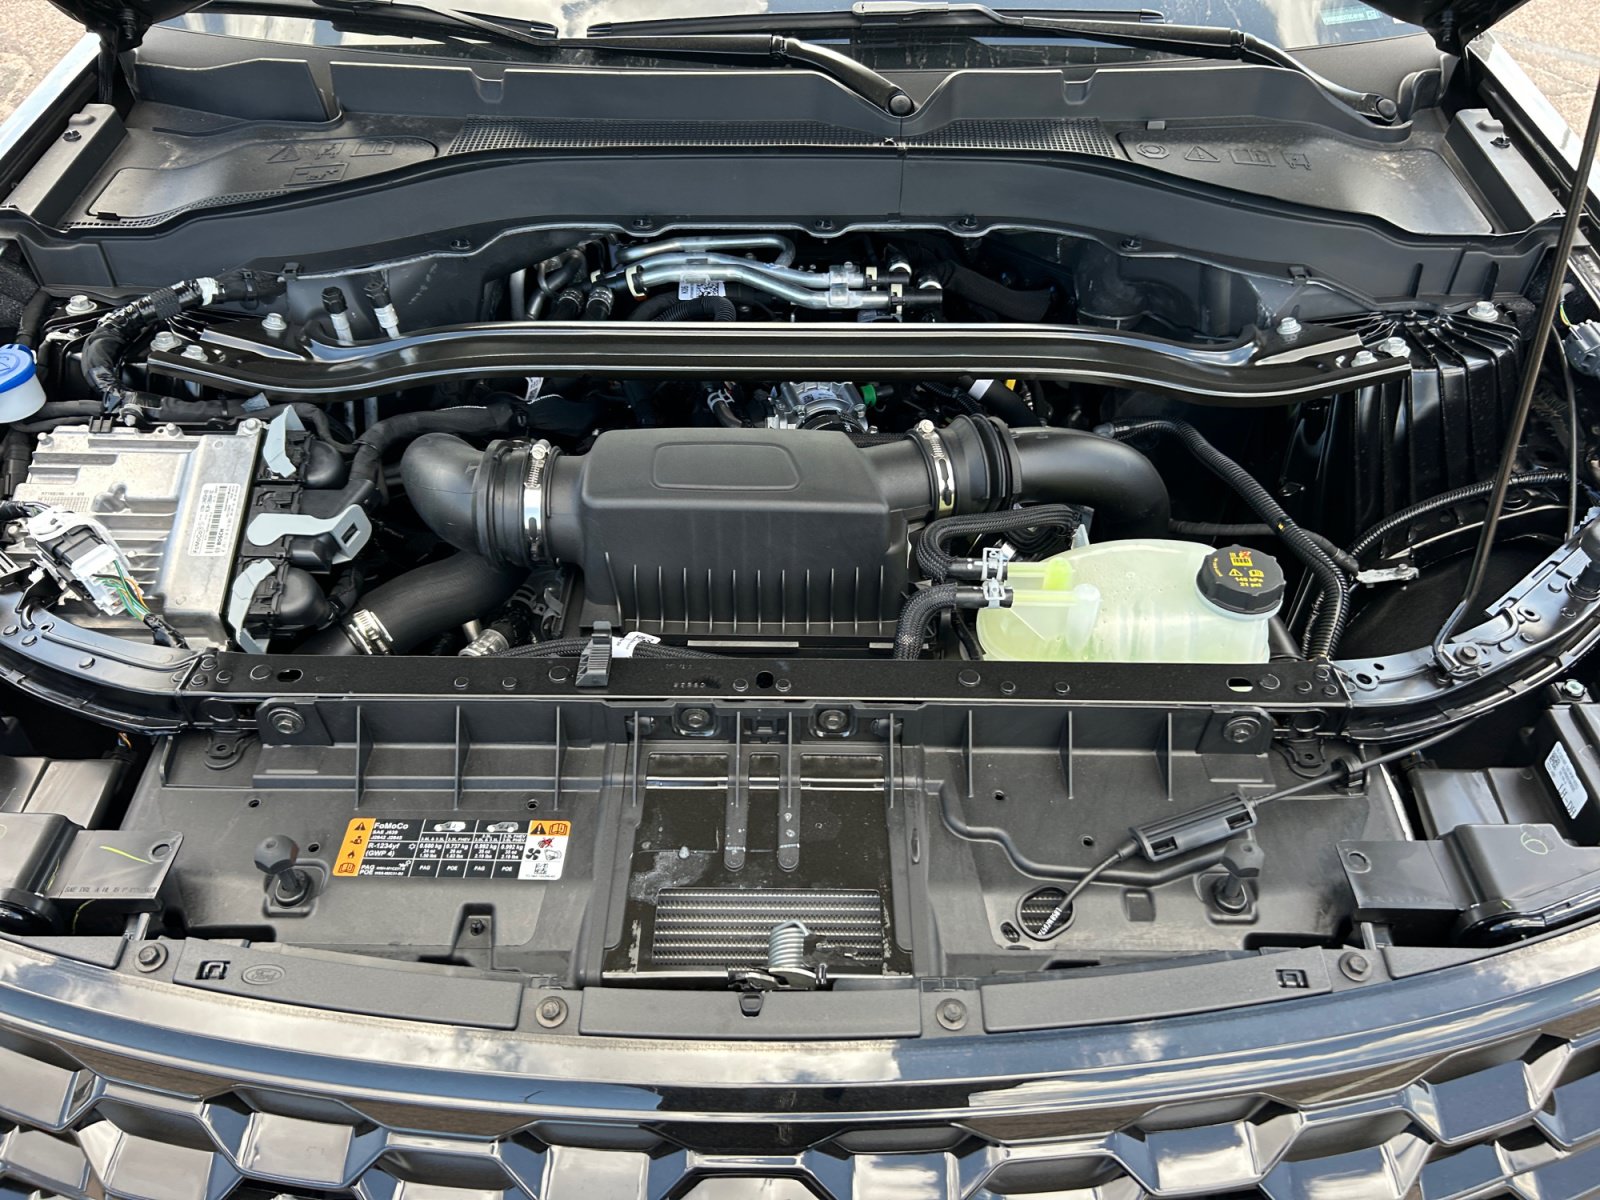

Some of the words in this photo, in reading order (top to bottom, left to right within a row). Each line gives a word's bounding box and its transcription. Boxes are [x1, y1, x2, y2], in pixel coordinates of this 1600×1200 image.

[216, 528, 224, 546] BOSCH
[373, 822, 409, 830] FoMoCo
[489, 843, 498, 851] kg
